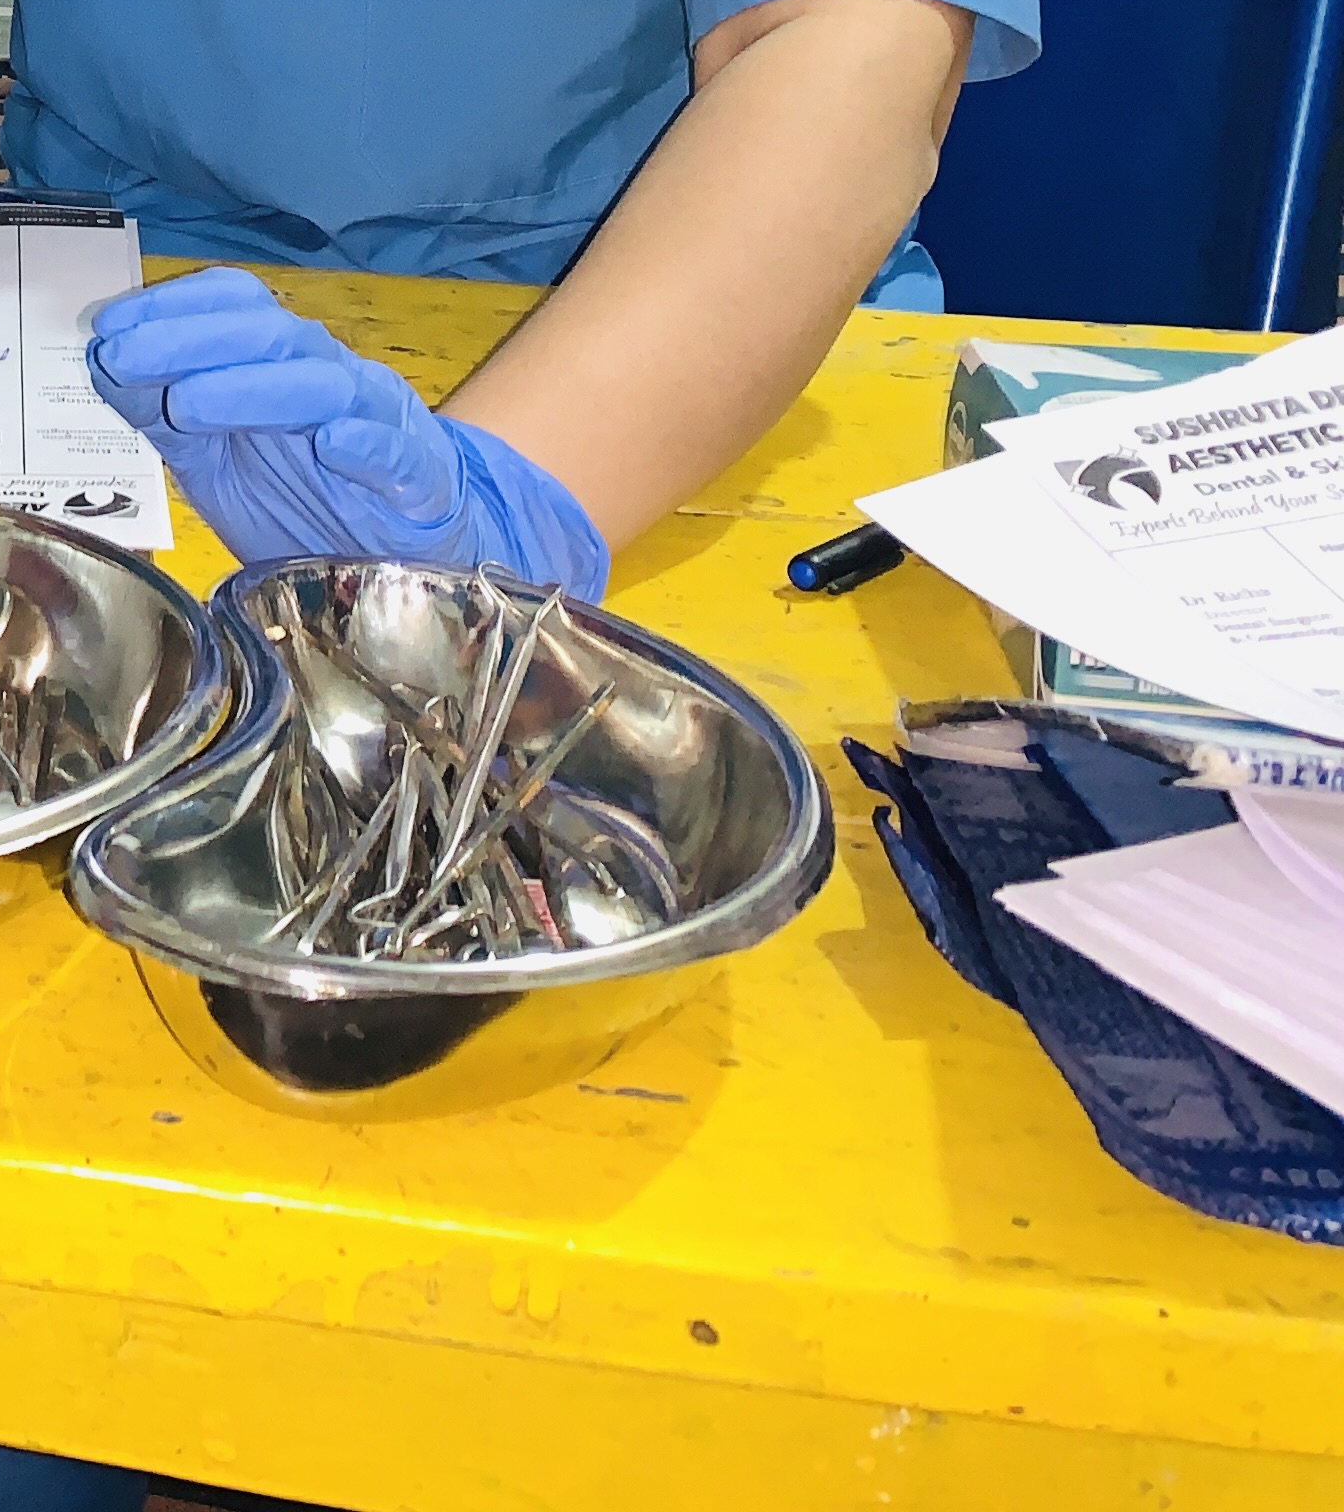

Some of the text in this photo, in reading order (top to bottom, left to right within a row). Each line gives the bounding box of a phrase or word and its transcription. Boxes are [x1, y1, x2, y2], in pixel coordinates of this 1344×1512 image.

[1133, 394, 1310, 445] SUSHRUTA
[1167, 422, 1344, 475] AESTHETIC
[1193, 455, 1344, 497] Dental & Sk
[1109, 510, 1186, 544] Experts
[1187, 494, 1265, 526] Behind
[1263, 492, 1319, 515] Your
